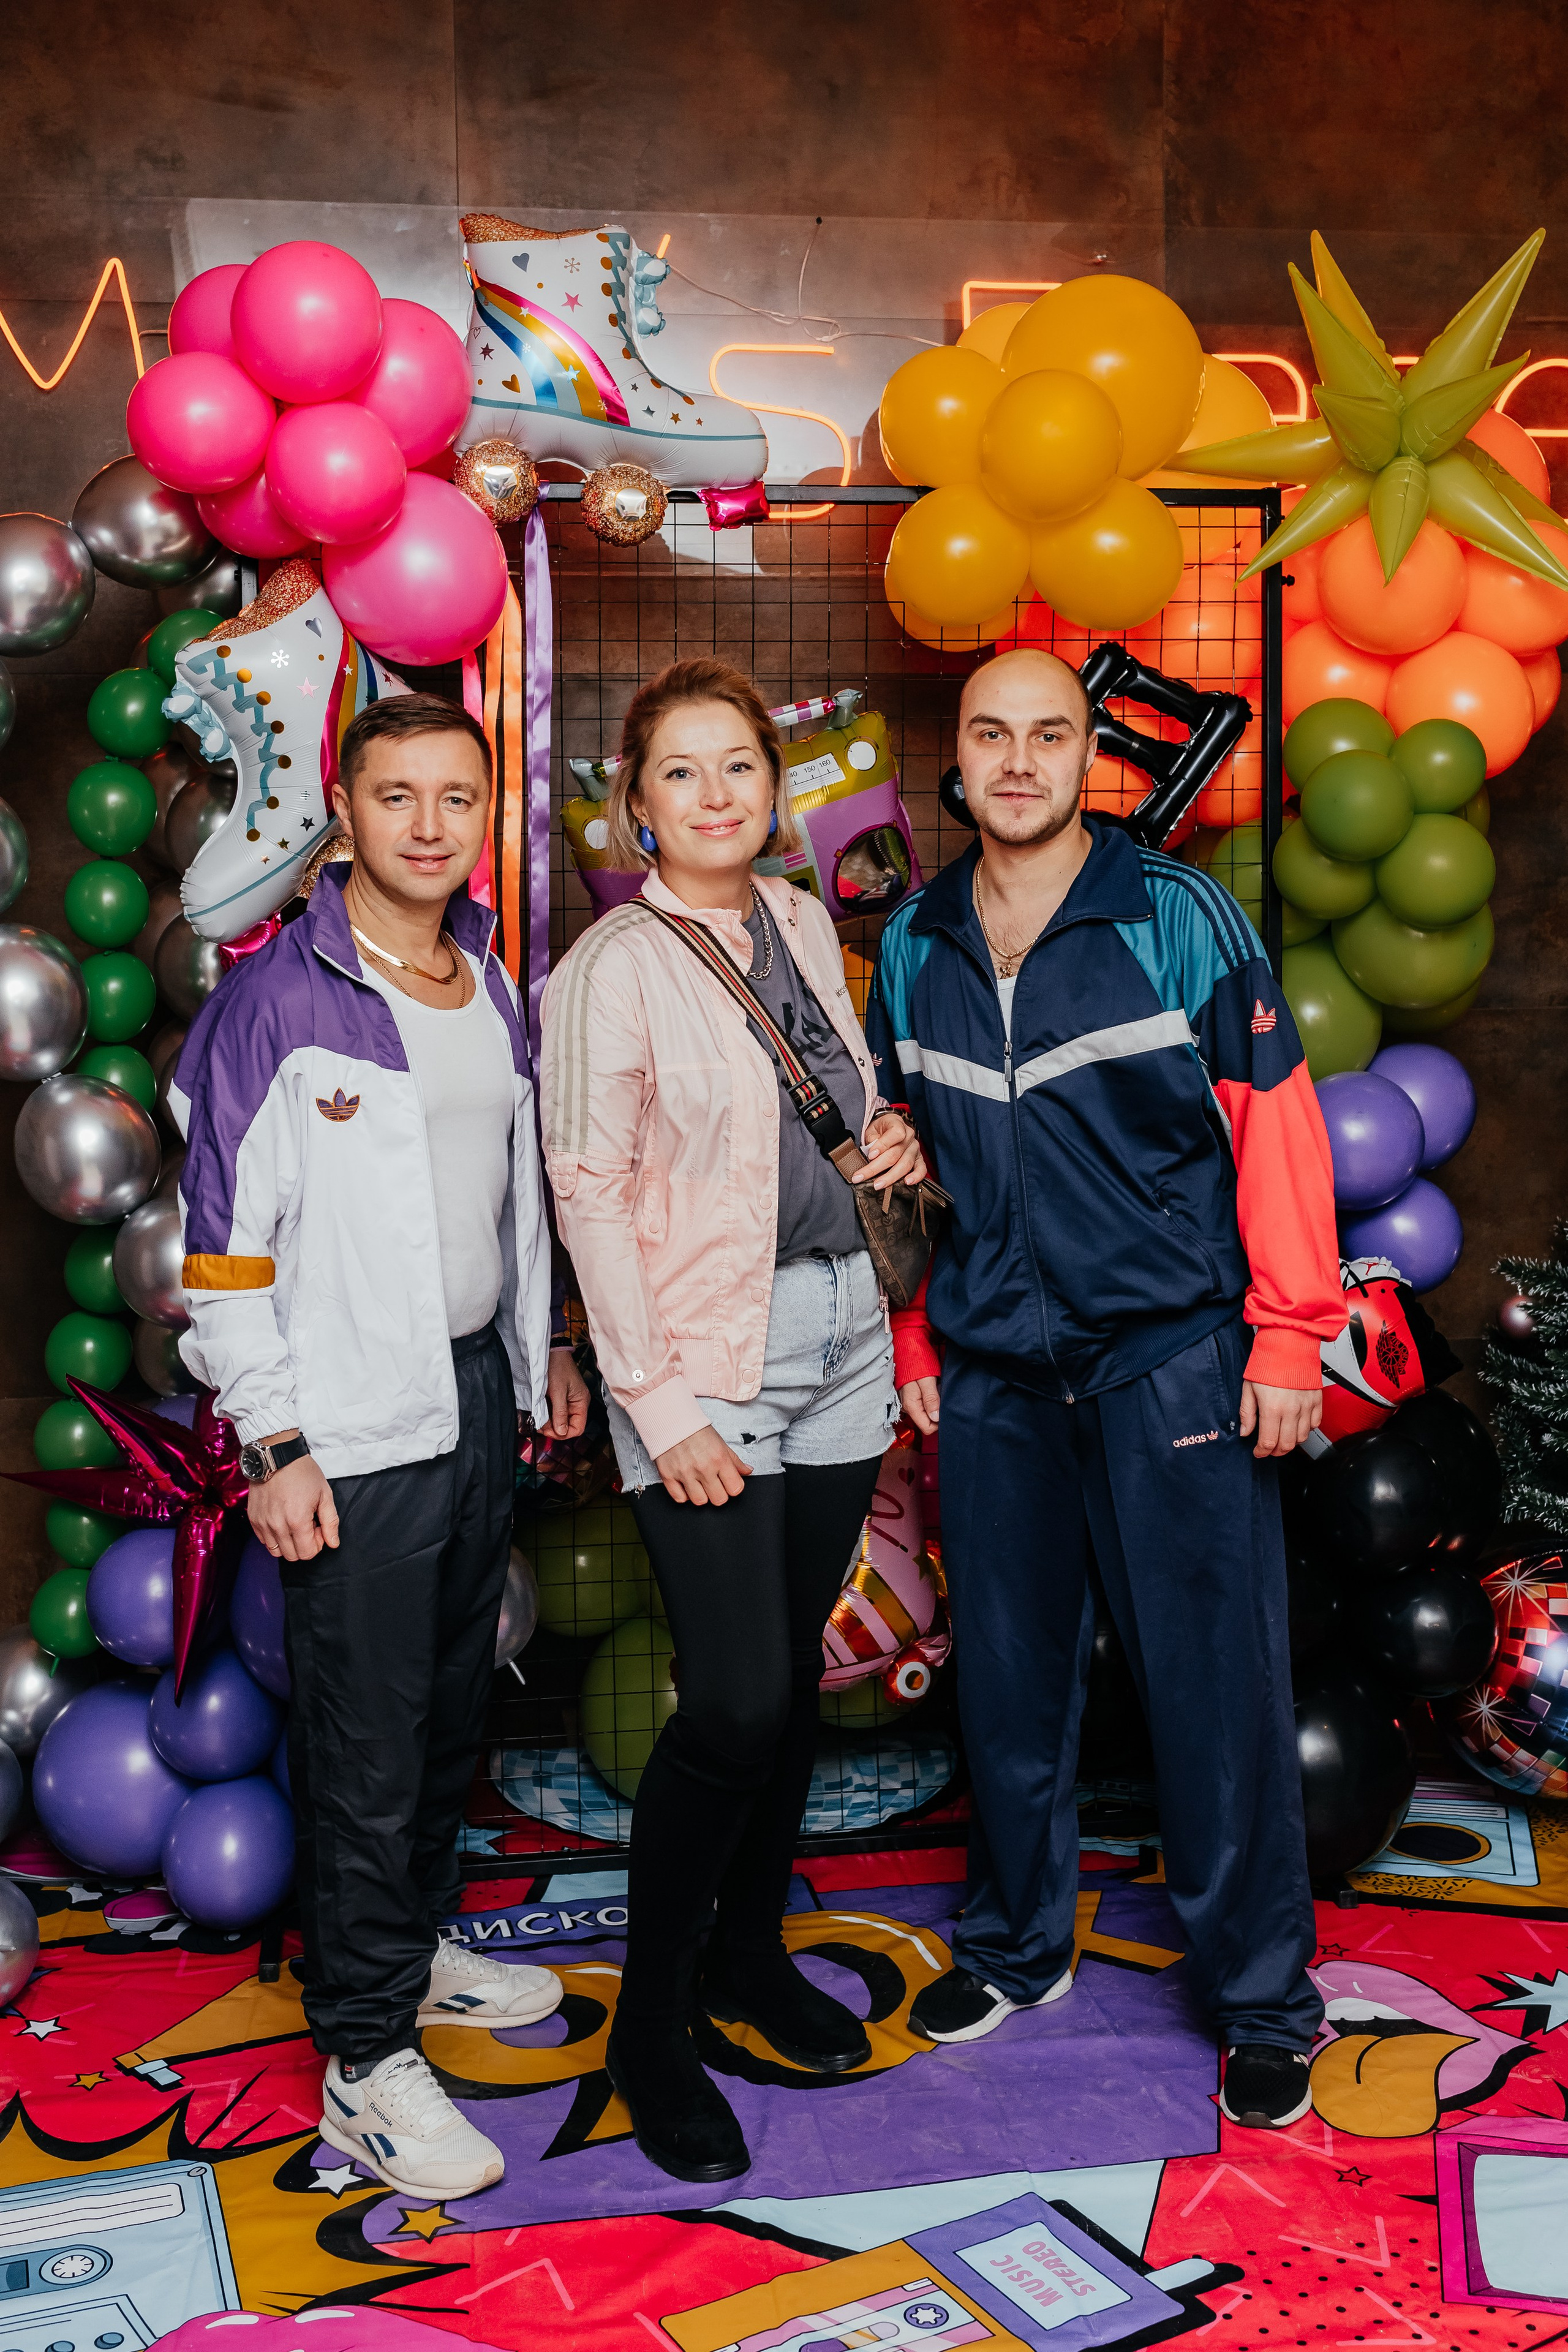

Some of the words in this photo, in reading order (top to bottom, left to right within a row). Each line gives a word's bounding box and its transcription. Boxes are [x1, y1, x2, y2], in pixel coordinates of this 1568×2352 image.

[818, 759, 831, 767] 160
[1173, 1434, 1207, 1447] adidas
[369, 2101, 393, 2128] Reebok
[989, 2254, 1065, 2307] MUSIC
[1022, 2241, 1097, 2297] STEREO
